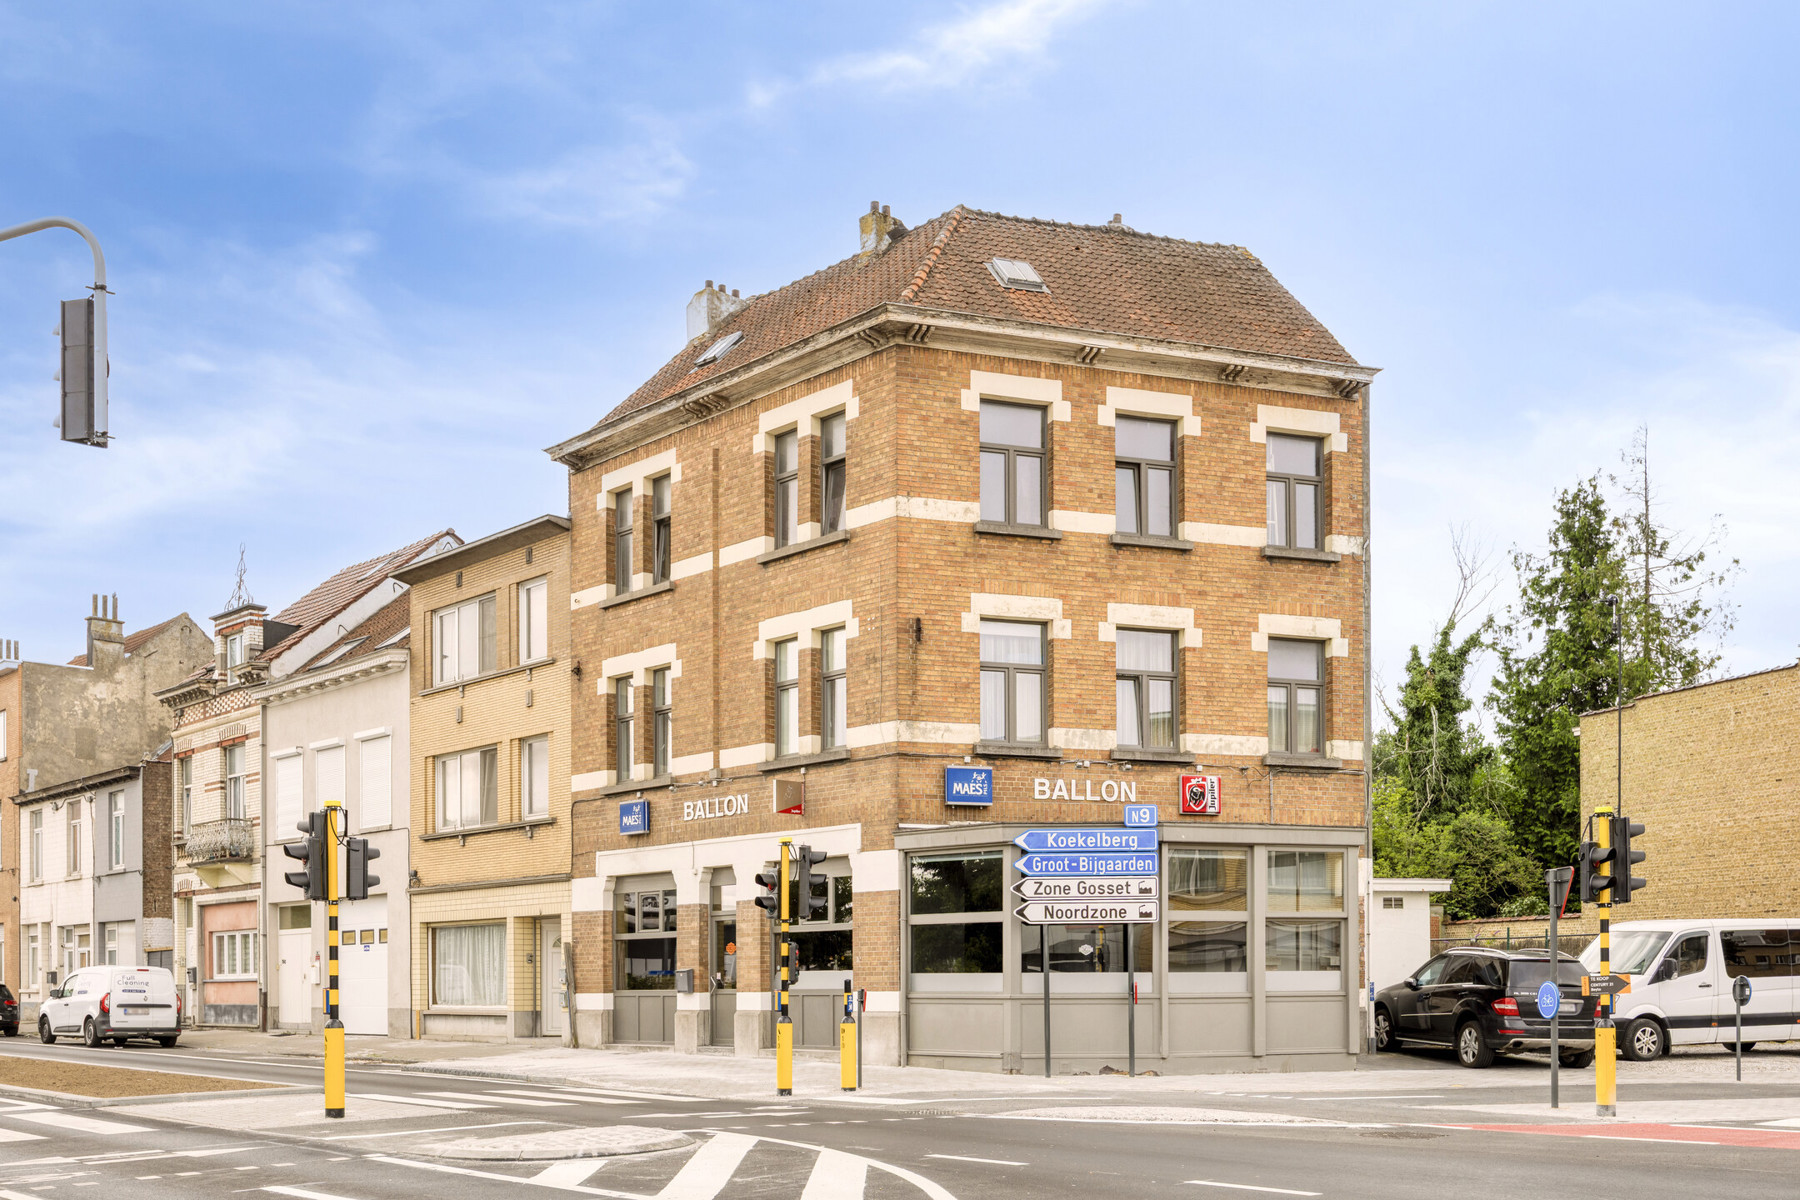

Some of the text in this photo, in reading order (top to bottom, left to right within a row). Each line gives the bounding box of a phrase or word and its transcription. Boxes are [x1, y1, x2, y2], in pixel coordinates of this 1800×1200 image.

[952, 782, 983, 796] MAES
[1034, 778, 1137, 803] BALLON
[1208, 778, 1217, 811] Jupiler
[683, 793, 749, 821] BALLON
[622, 814, 639, 826] MAES
[1131, 808, 1150, 823] N9
[1047, 833, 1138, 850] Koekelberg
[1032, 857, 1153, 874] Groot-Bijgaarden
[1033, 881, 1131, 896] Zone Gosset
[1044, 905, 1127, 919] Noordzone
